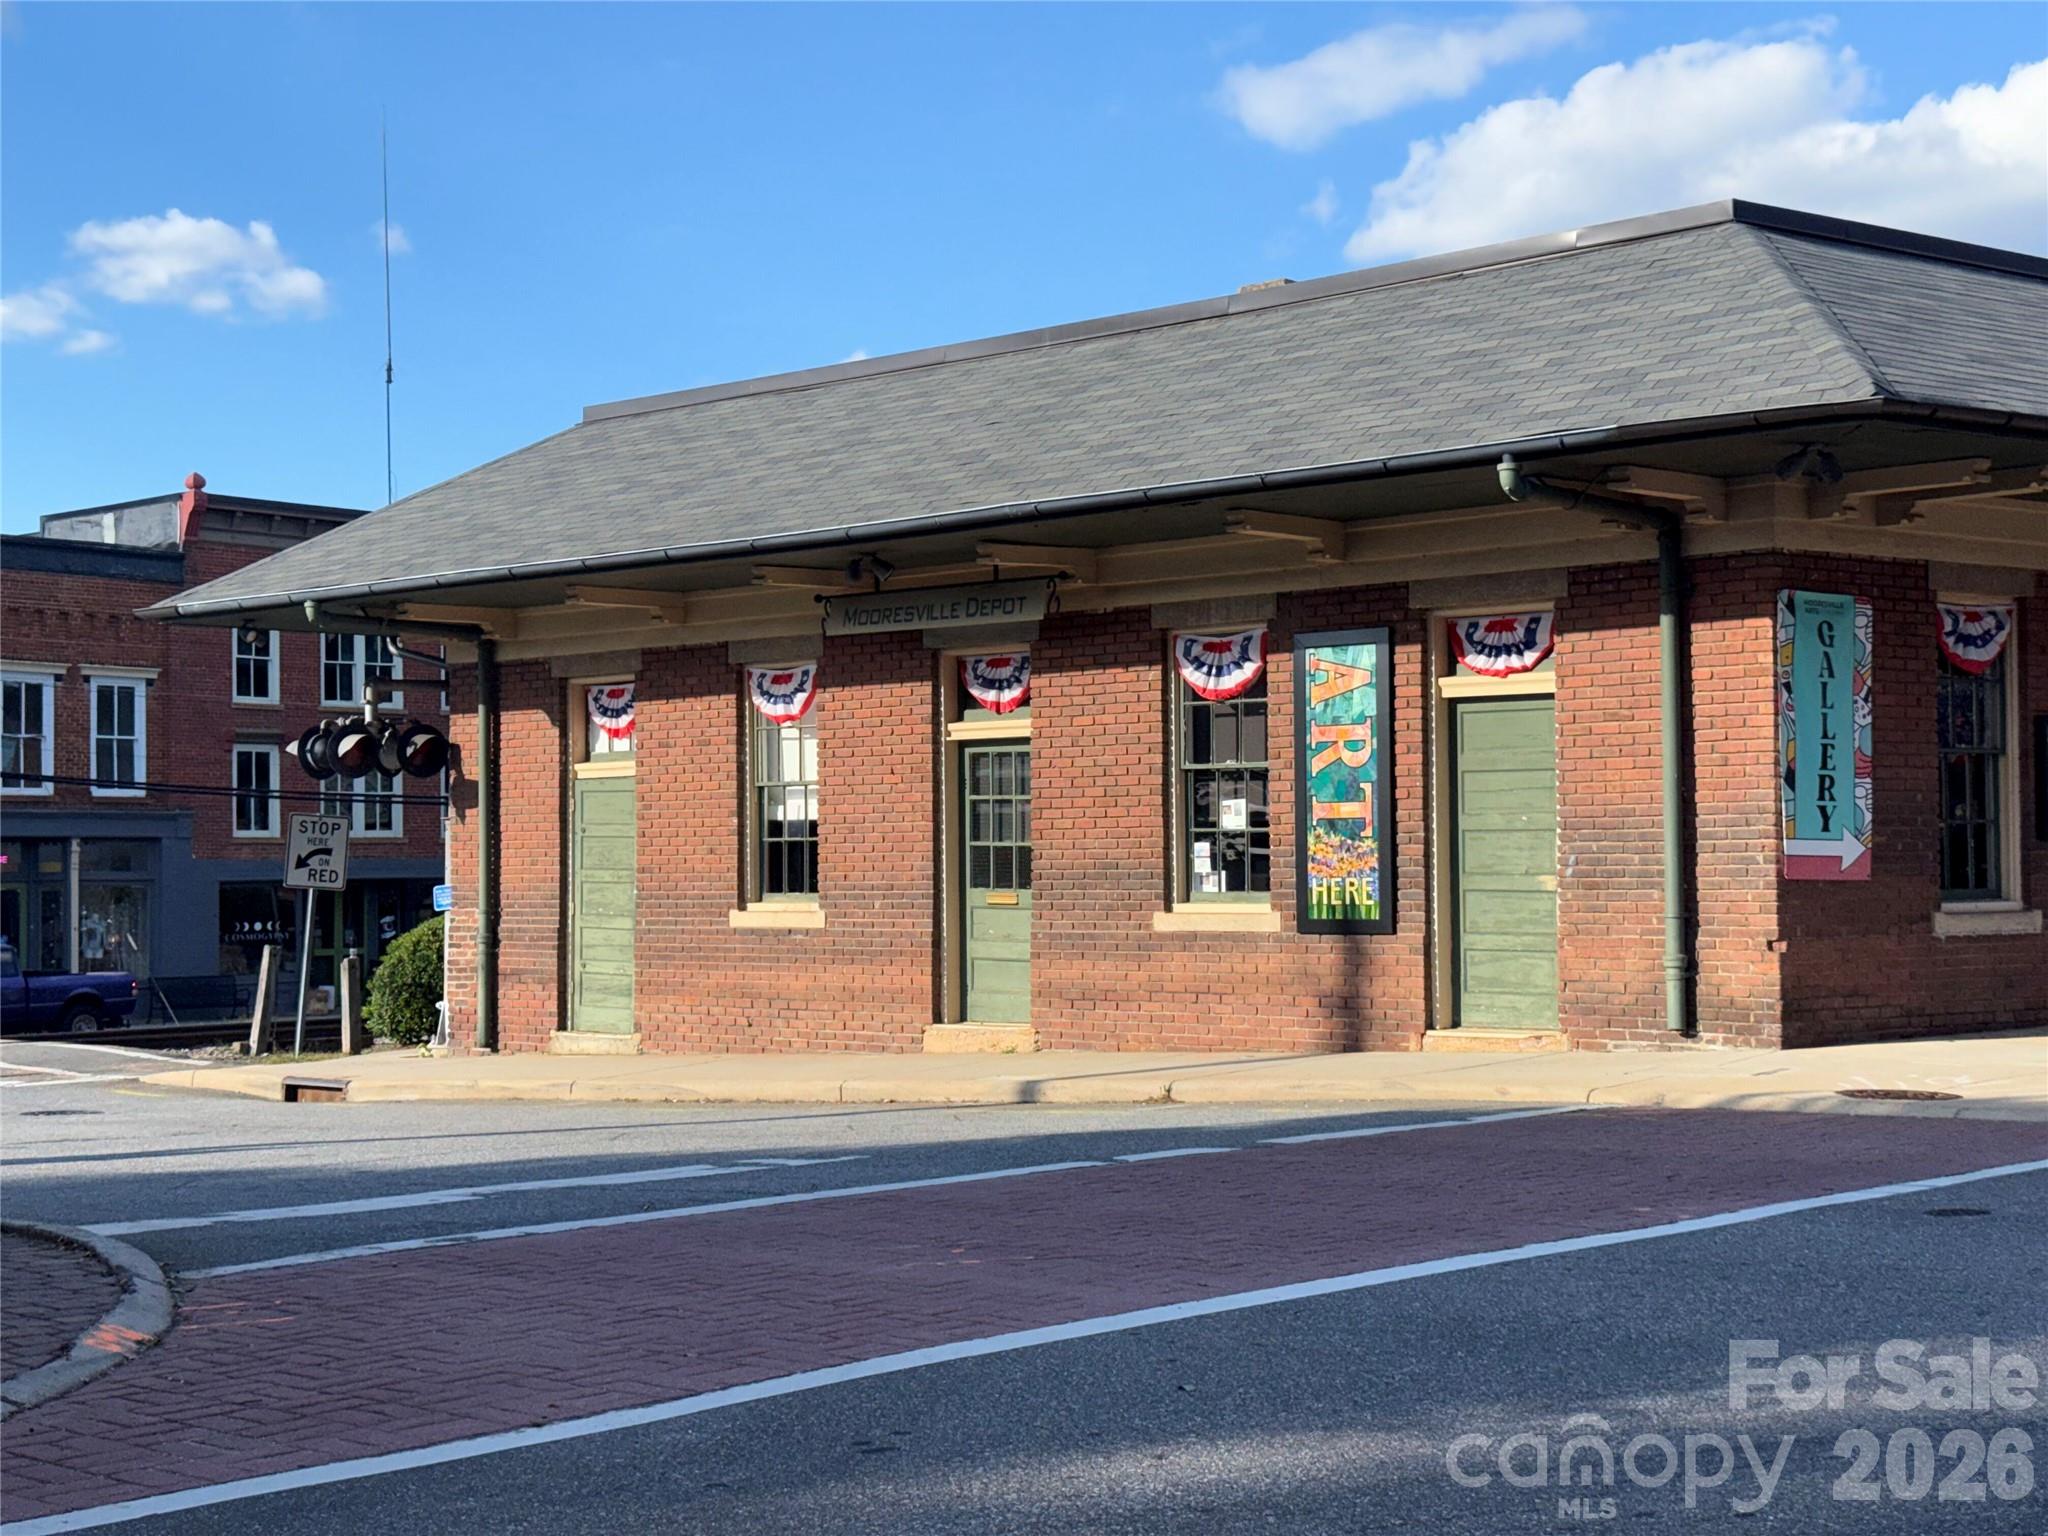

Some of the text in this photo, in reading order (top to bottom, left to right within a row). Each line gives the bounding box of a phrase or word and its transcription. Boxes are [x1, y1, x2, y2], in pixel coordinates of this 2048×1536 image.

[842, 596, 1027, 628] MOORESVILLE DEPOT
[1816, 619, 1837, 833] GALLERY
[1309, 652, 1373, 839] ART
[298, 819, 341, 837] STOP
[307, 838, 329, 847] HERE
[318, 857, 330, 867] ON
[307, 868, 339, 884] RED
[1311, 877, 1375, 906] HERE
